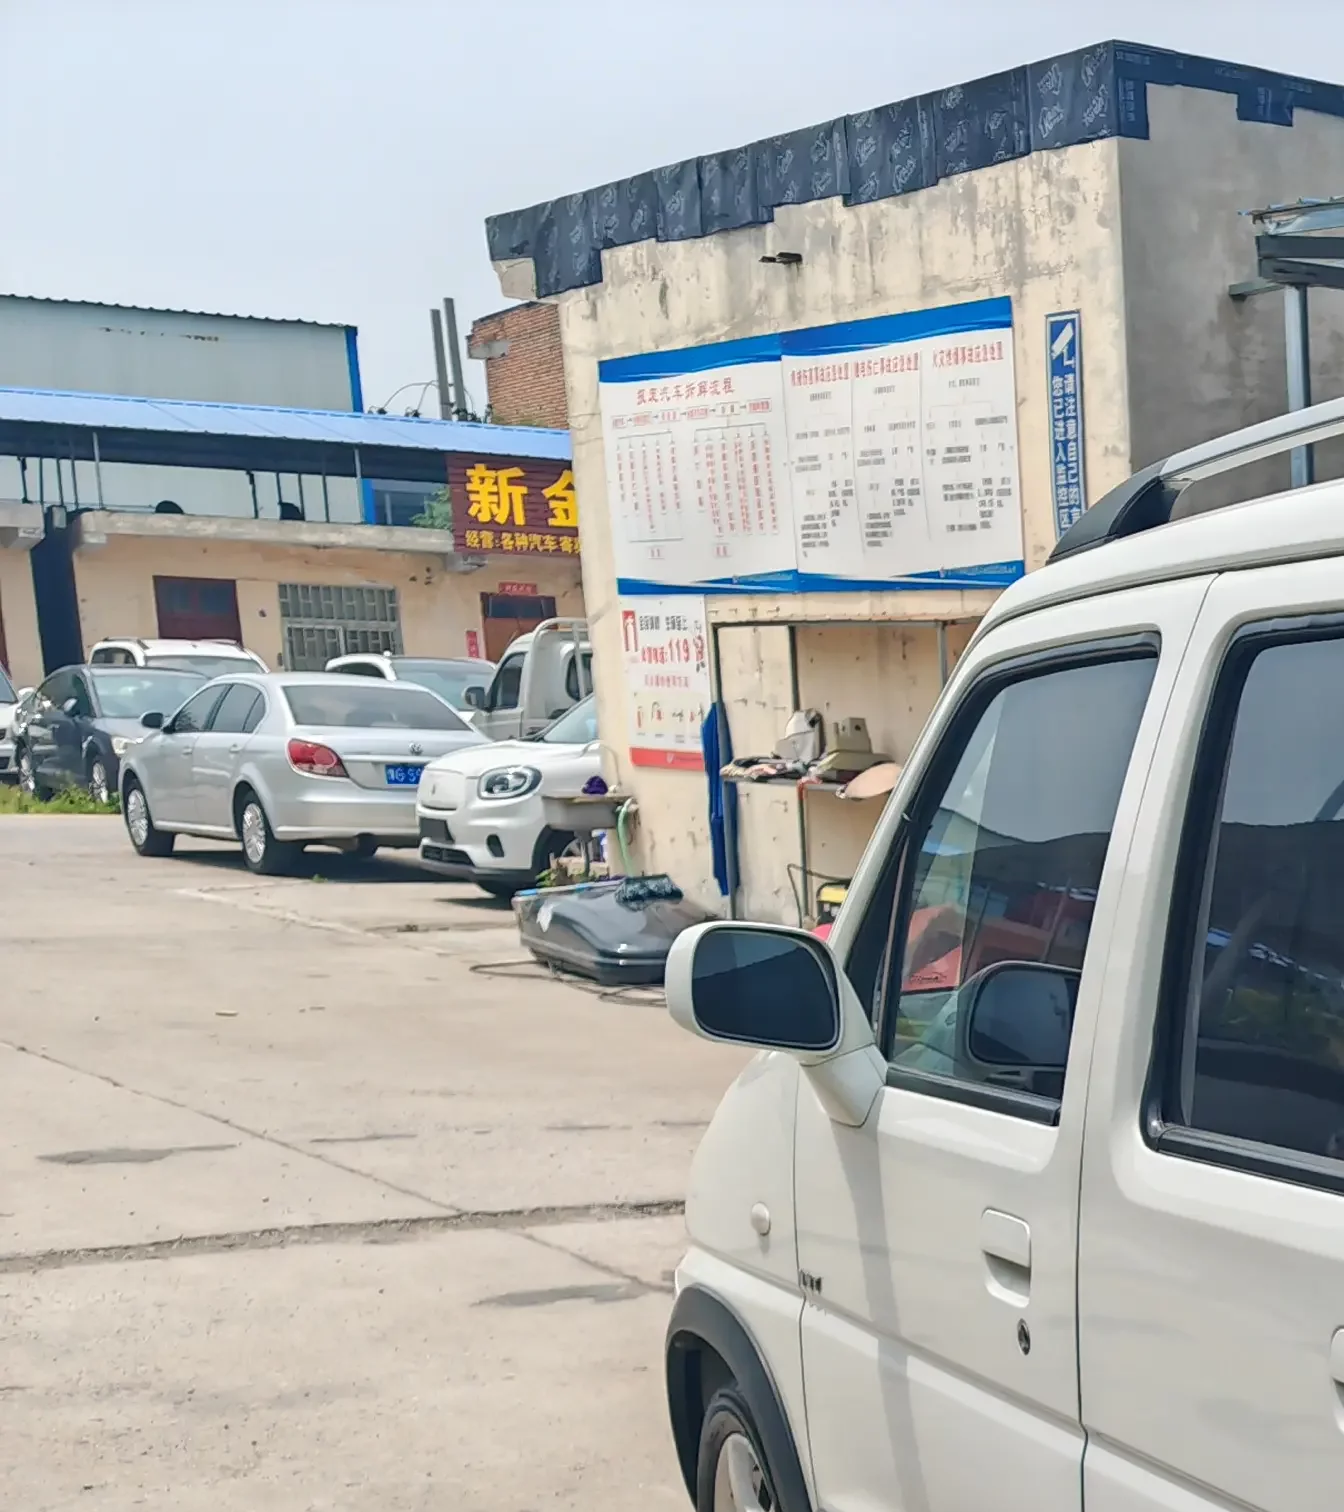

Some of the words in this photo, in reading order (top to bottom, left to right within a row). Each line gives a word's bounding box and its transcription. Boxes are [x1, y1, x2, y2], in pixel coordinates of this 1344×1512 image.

[1052, 375, 1072, 535] 您已进入监控区
